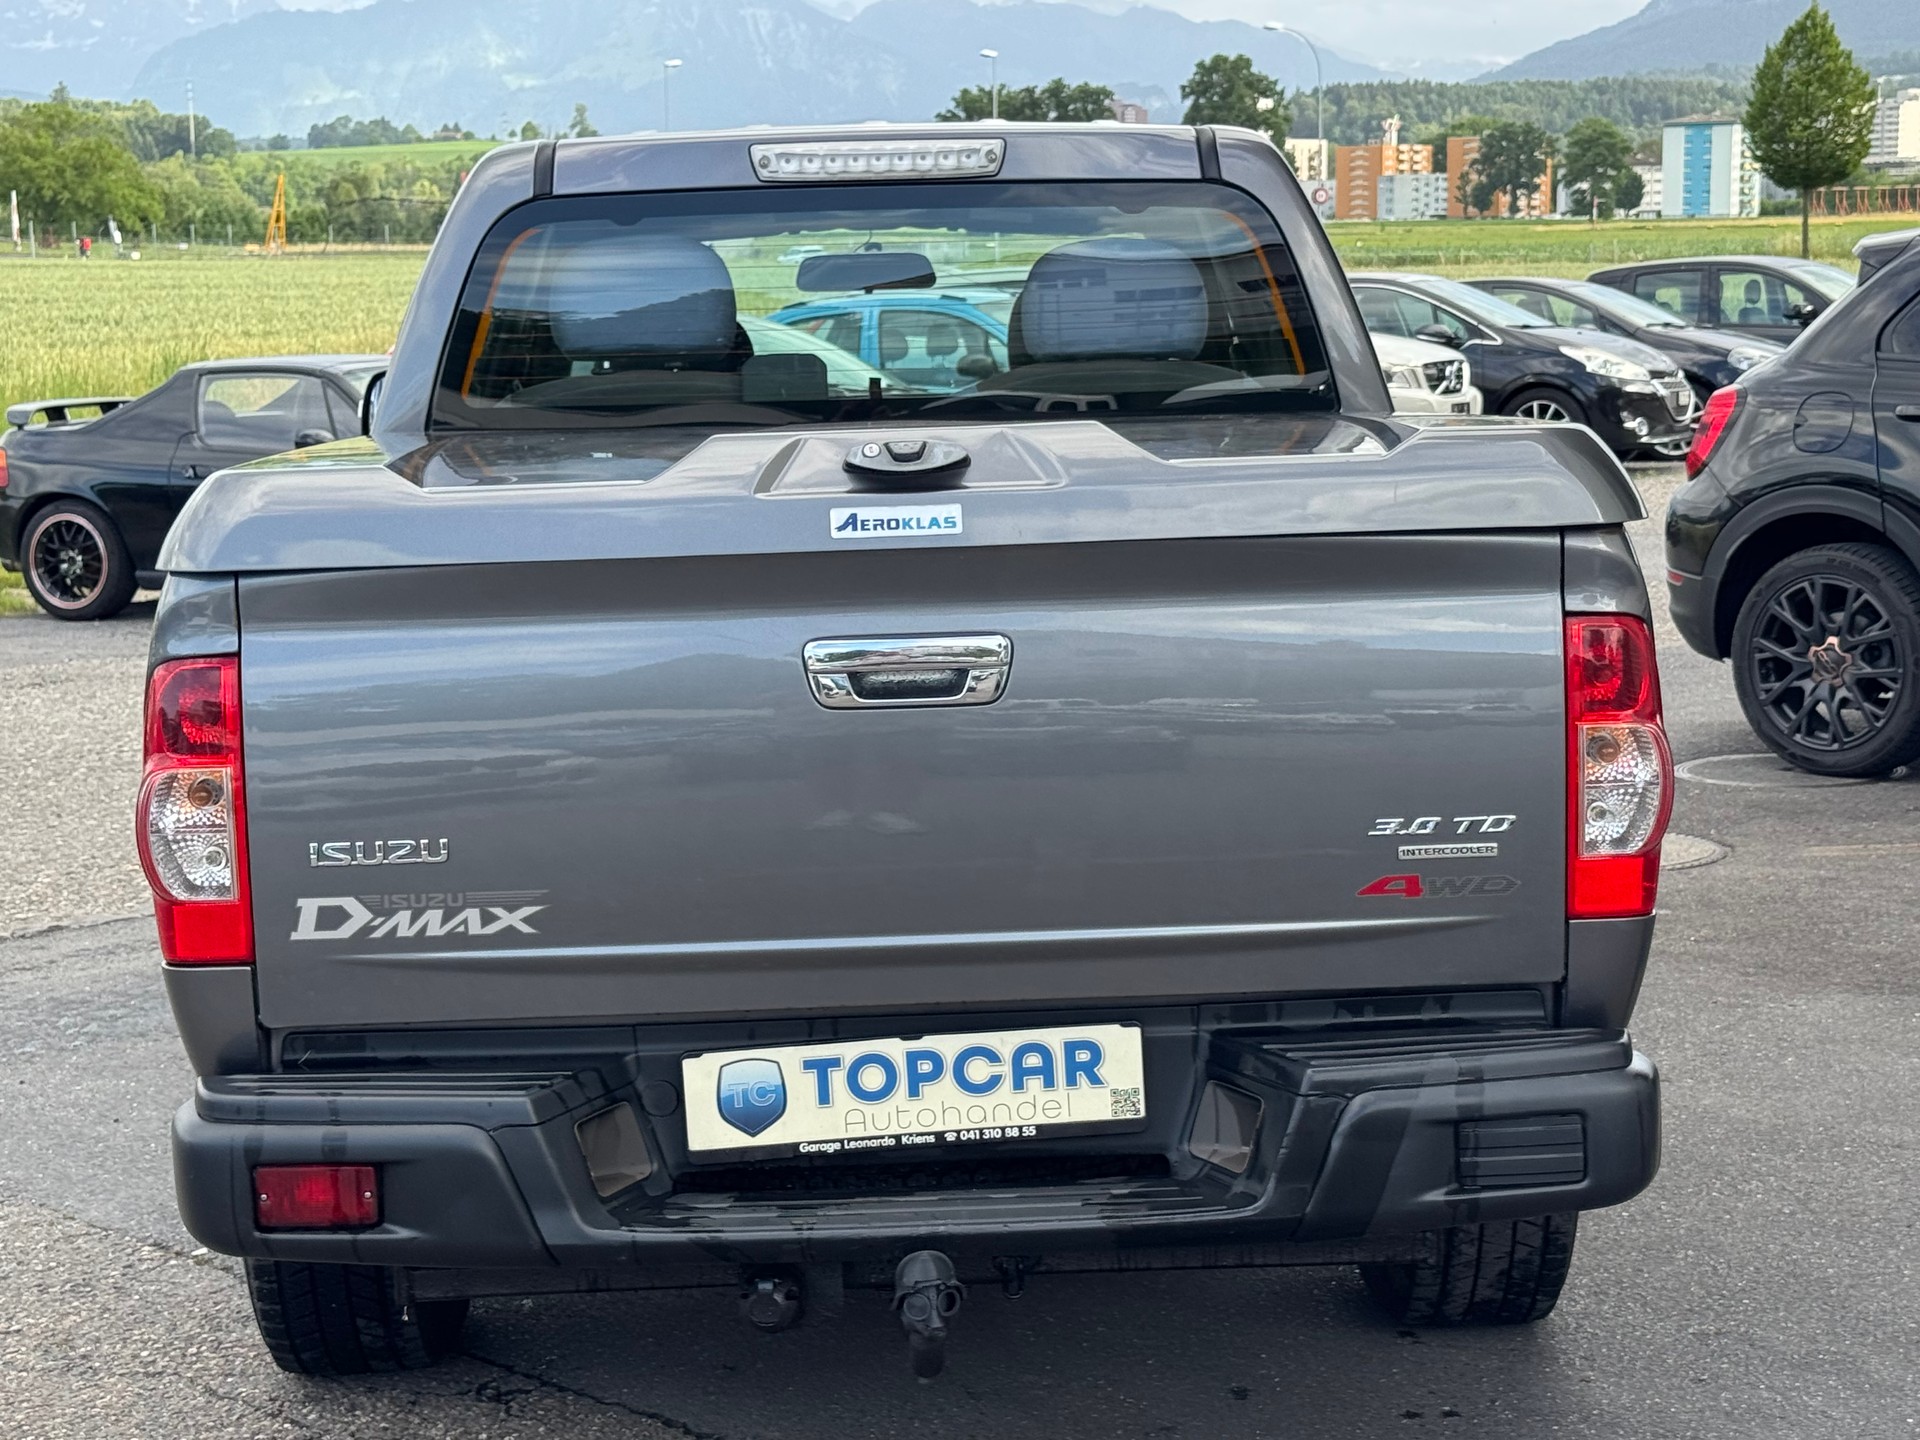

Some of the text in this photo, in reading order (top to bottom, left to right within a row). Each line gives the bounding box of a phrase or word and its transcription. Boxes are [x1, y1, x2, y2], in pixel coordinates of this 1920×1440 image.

[834, 513, 957, 532] AEROKLAS
[1367, 814, 1517, 836] 3.0 TD
[309, 838, 449, 867] ISUZU
[1400, 845, 1495, 857] INTERCOOLER
[1356, 873, 1521, 899] 4WD
[383, 892, 465, 908] ISUZU
[801, 1039, 1108, 1108] TOPCAR
[727, 1081, 776, 1108] TC
[844, 1093, 1072, 1133] Autohandel
[799, 1142, 841, 1153] Garage
[843, 1136, 896, 1149] Leonardo
[901, 1134, 936, 1145] Kriens
[959, 1130, 980, 1140] 041
[982, 1128, 1002, 1139] 310
[1021, 1126, 1037, 1136] 55
